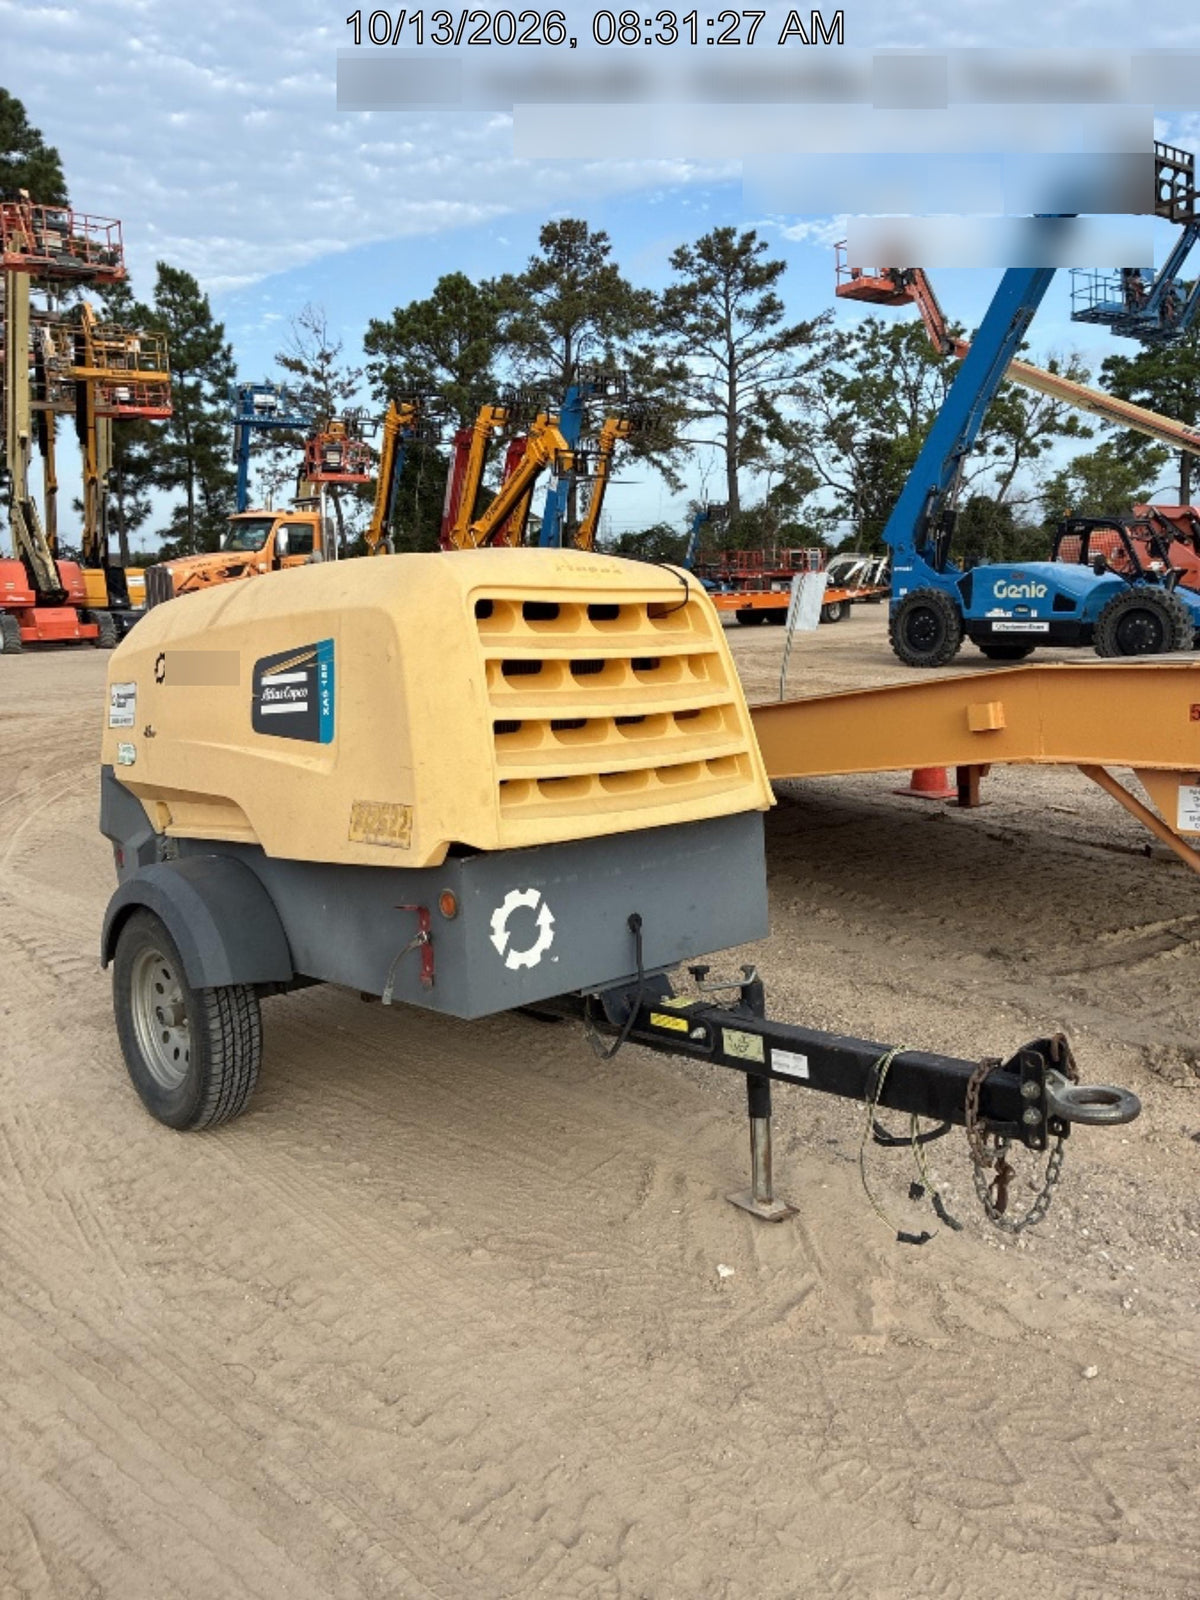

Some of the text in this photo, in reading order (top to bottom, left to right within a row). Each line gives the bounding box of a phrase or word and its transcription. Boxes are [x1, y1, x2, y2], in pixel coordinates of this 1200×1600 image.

[993, 579, 1048, 599] Genie
[261, 685, 308, 701] Atlas Copco
